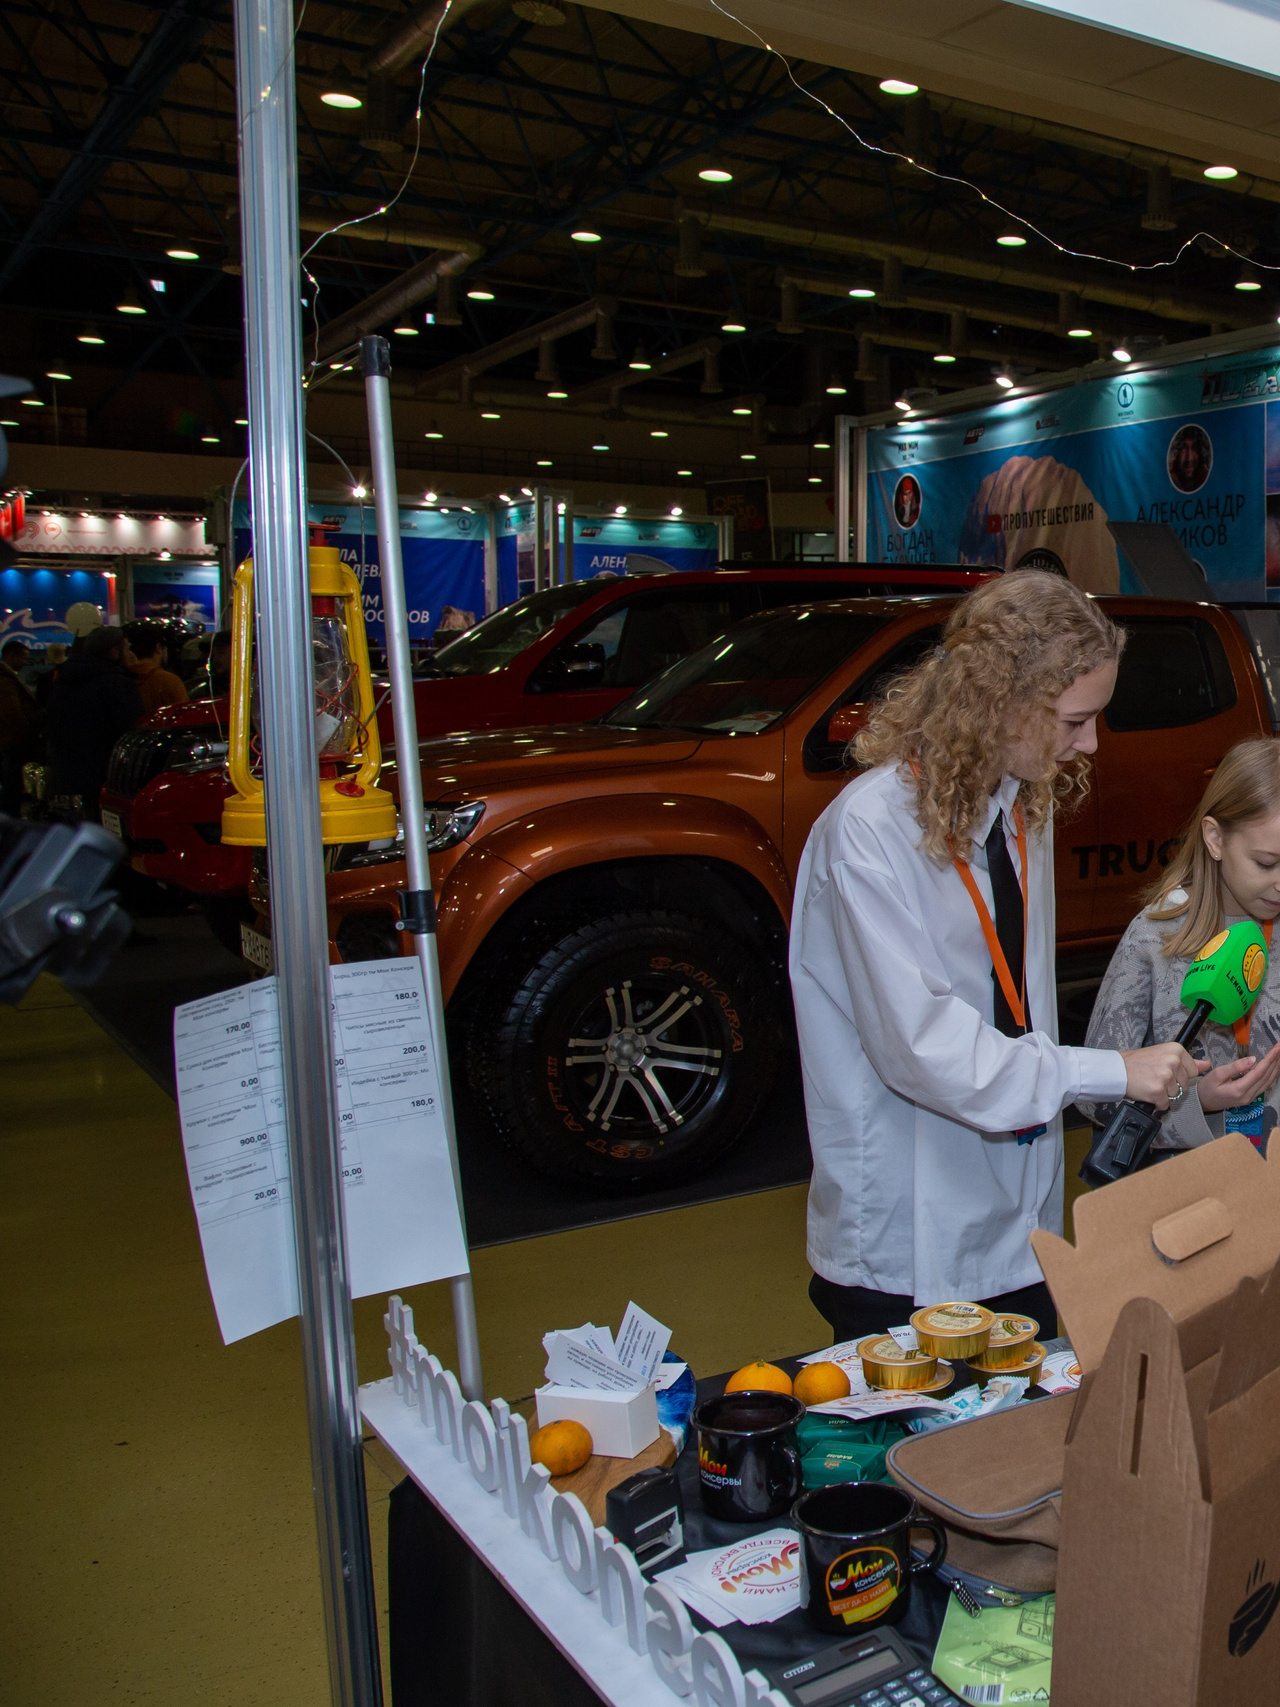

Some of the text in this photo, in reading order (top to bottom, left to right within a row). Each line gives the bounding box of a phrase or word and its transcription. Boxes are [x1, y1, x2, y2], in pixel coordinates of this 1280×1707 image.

[1136, 494, 1246, 523] АЛЕКСАНДР
[1002, 502, 1094, 531] ПРОПУТЕШЕСТВИЯ
[886, 530, 934, 554] БОГДАН
[1175, 524, 1229, 548] ИКОВ
[590, 555, 628, 569] АЛЕН
[1071, 838, 1178, 880] TRUC
[1226, 970, 1244, 996] LEMON
[395, 991, 417, 1000] 180,0
[648, 956, 744, 1053] SAHARA
[225, 1021, 251, 1034] 170,00
[365, 1020, 387, 1028] мясные
[403, 1044, 425, 1055] 200,0
[240, 1077, 258, 1088] 0,00
[351, 1078, 376, 1086] Индейка
[411, 1097, 434, 1107] 180,0
[240, 1133, 267, 1146] 900,00
[586, 1138, 654, 1159] CST
[254, 1188, 277, 1200] 20,00
[739, 1540, 790, 1550] ВСЕГДА
[726, 1553, 772, 1575] консервы
[840, 1558, 883, 1588] Мои
[854, 1560, 896, 1589] консервы
[743, 1586, 786, 1595] НАМИ
[833, 1599, 861, 1612] ВСЕГДА
[783, 1661, 815, 1679] CITIZEN
